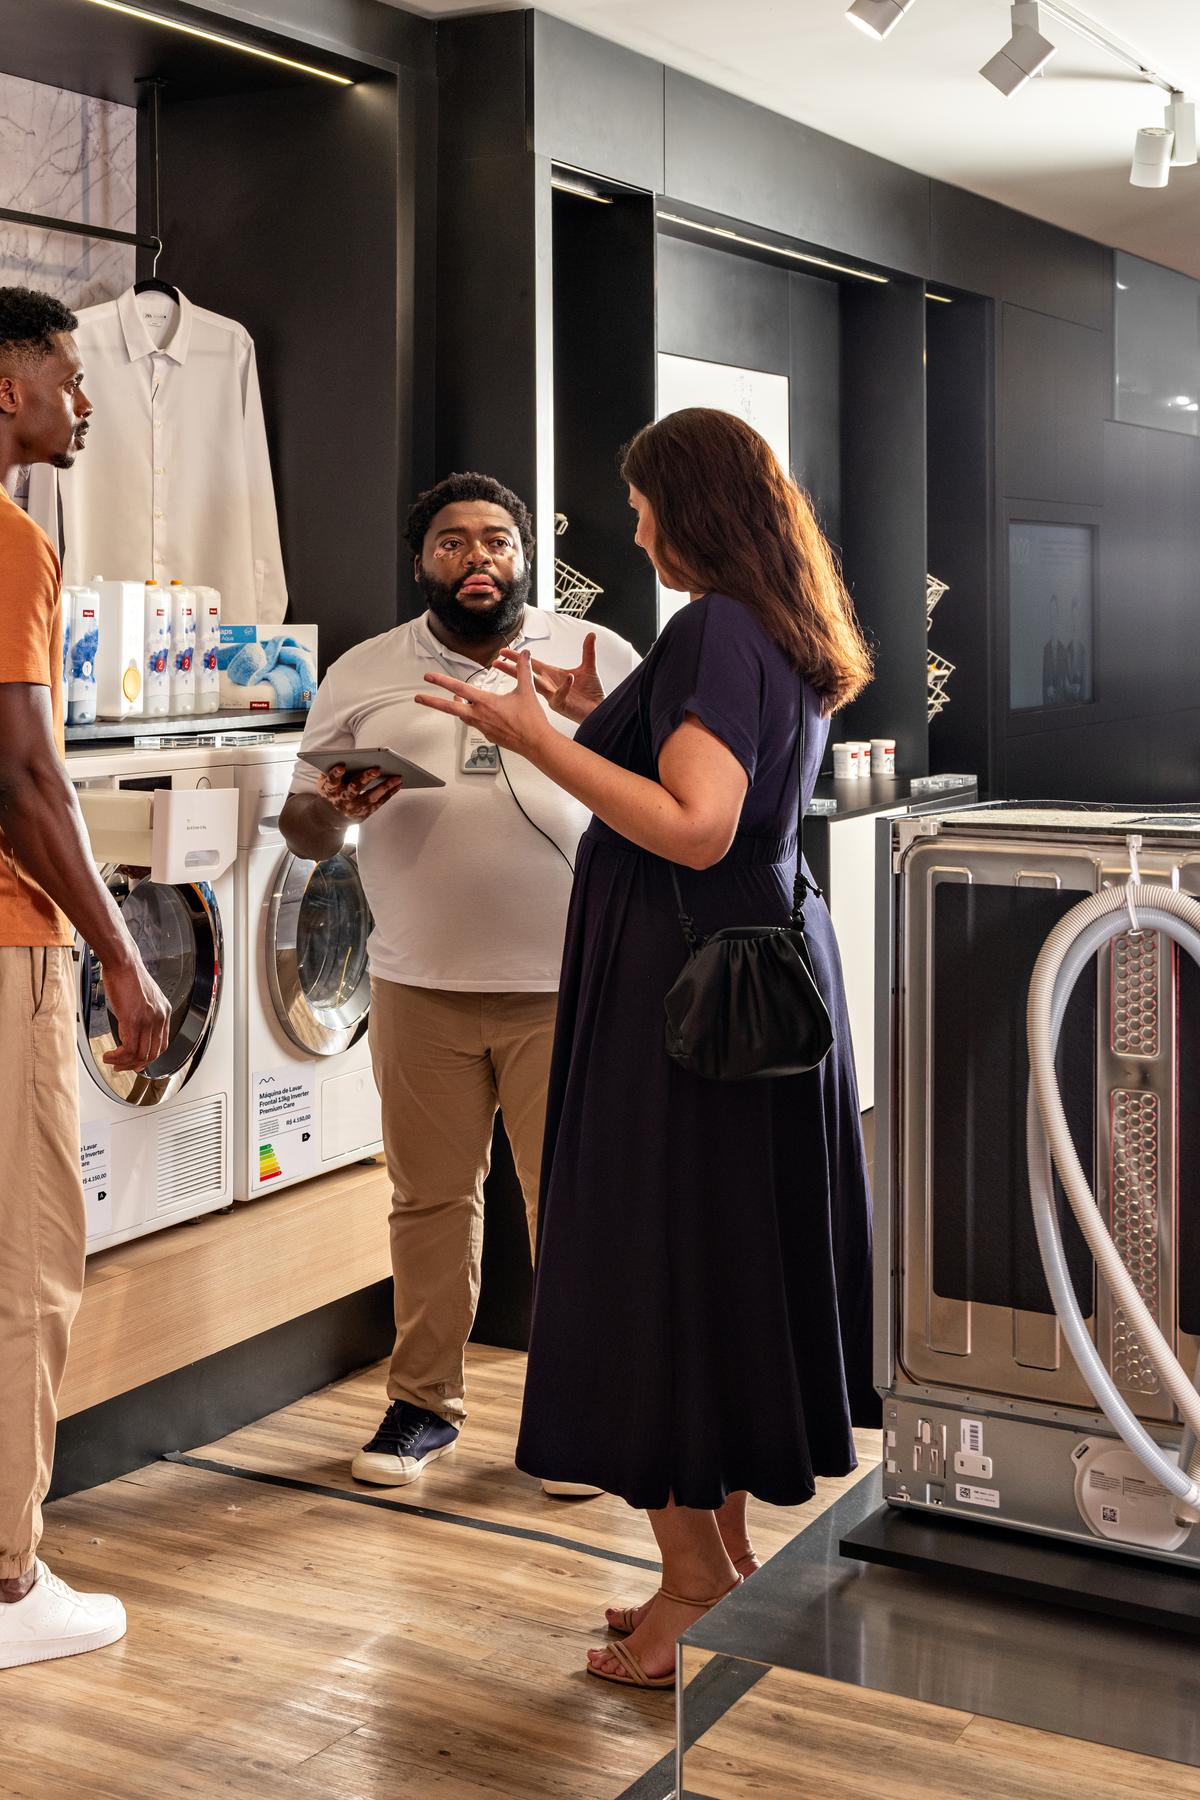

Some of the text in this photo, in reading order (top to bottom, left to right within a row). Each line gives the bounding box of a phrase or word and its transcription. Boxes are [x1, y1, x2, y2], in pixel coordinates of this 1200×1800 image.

[259, 1090, 281, 1099] Máquina
[259, 1097, 277, 1107] Frontal
[291, 1091, 309, 1099] Inverter
[259, 1104, 282, 1115] Premium
